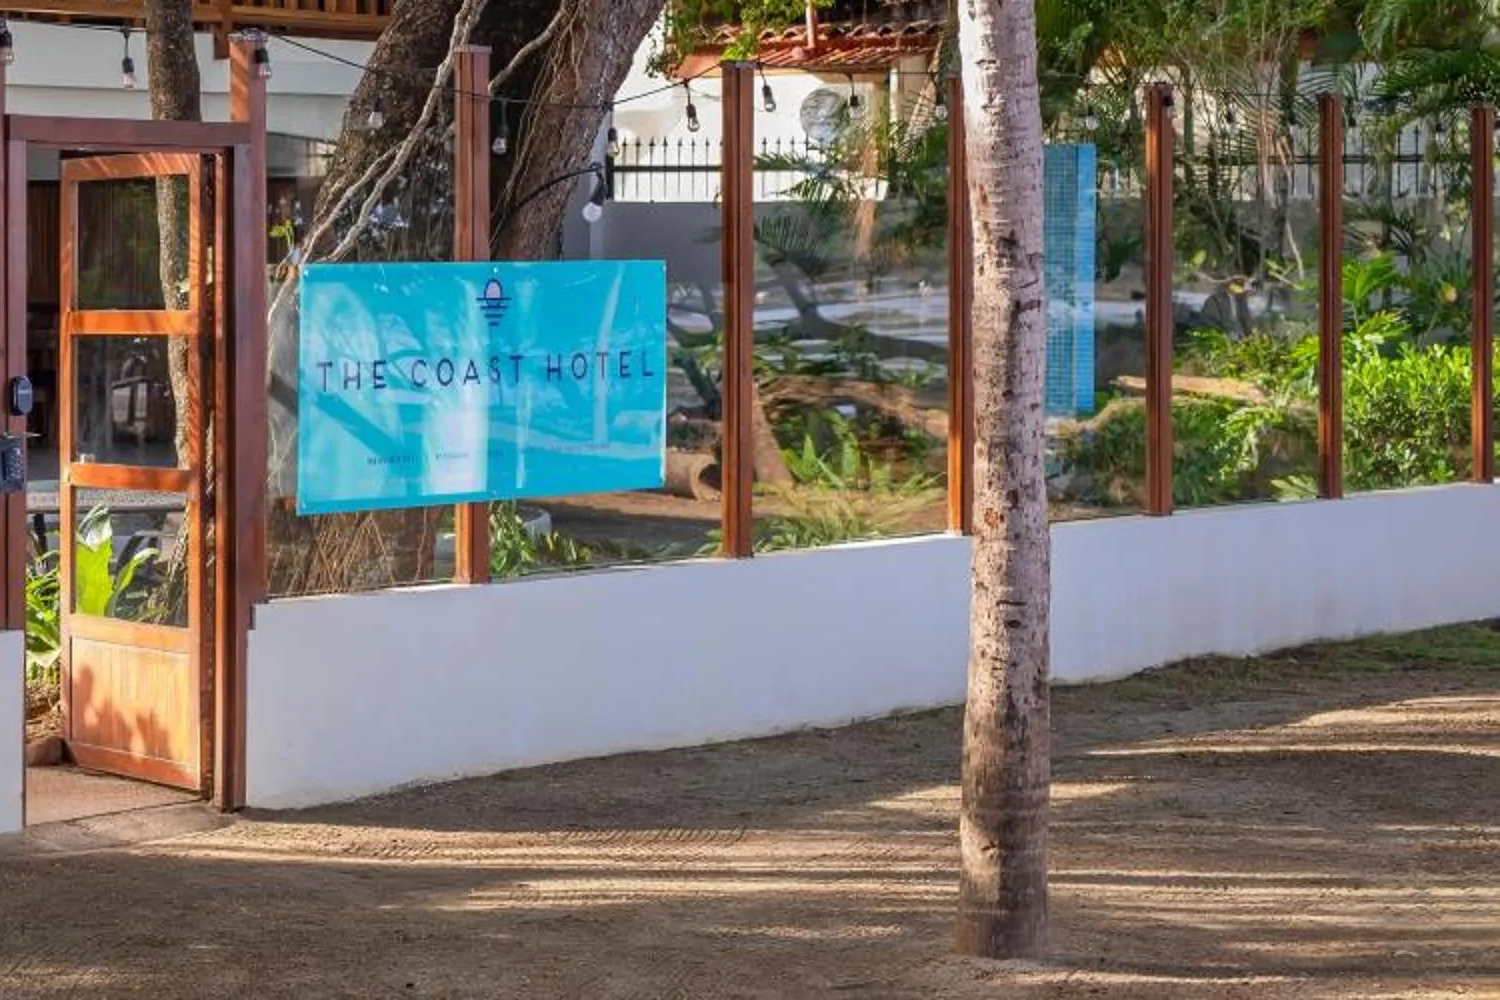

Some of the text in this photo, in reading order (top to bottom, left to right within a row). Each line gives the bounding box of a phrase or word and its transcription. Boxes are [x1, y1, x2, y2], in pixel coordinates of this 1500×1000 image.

[316, 351, 653, 392] THE COAST HOTEL
